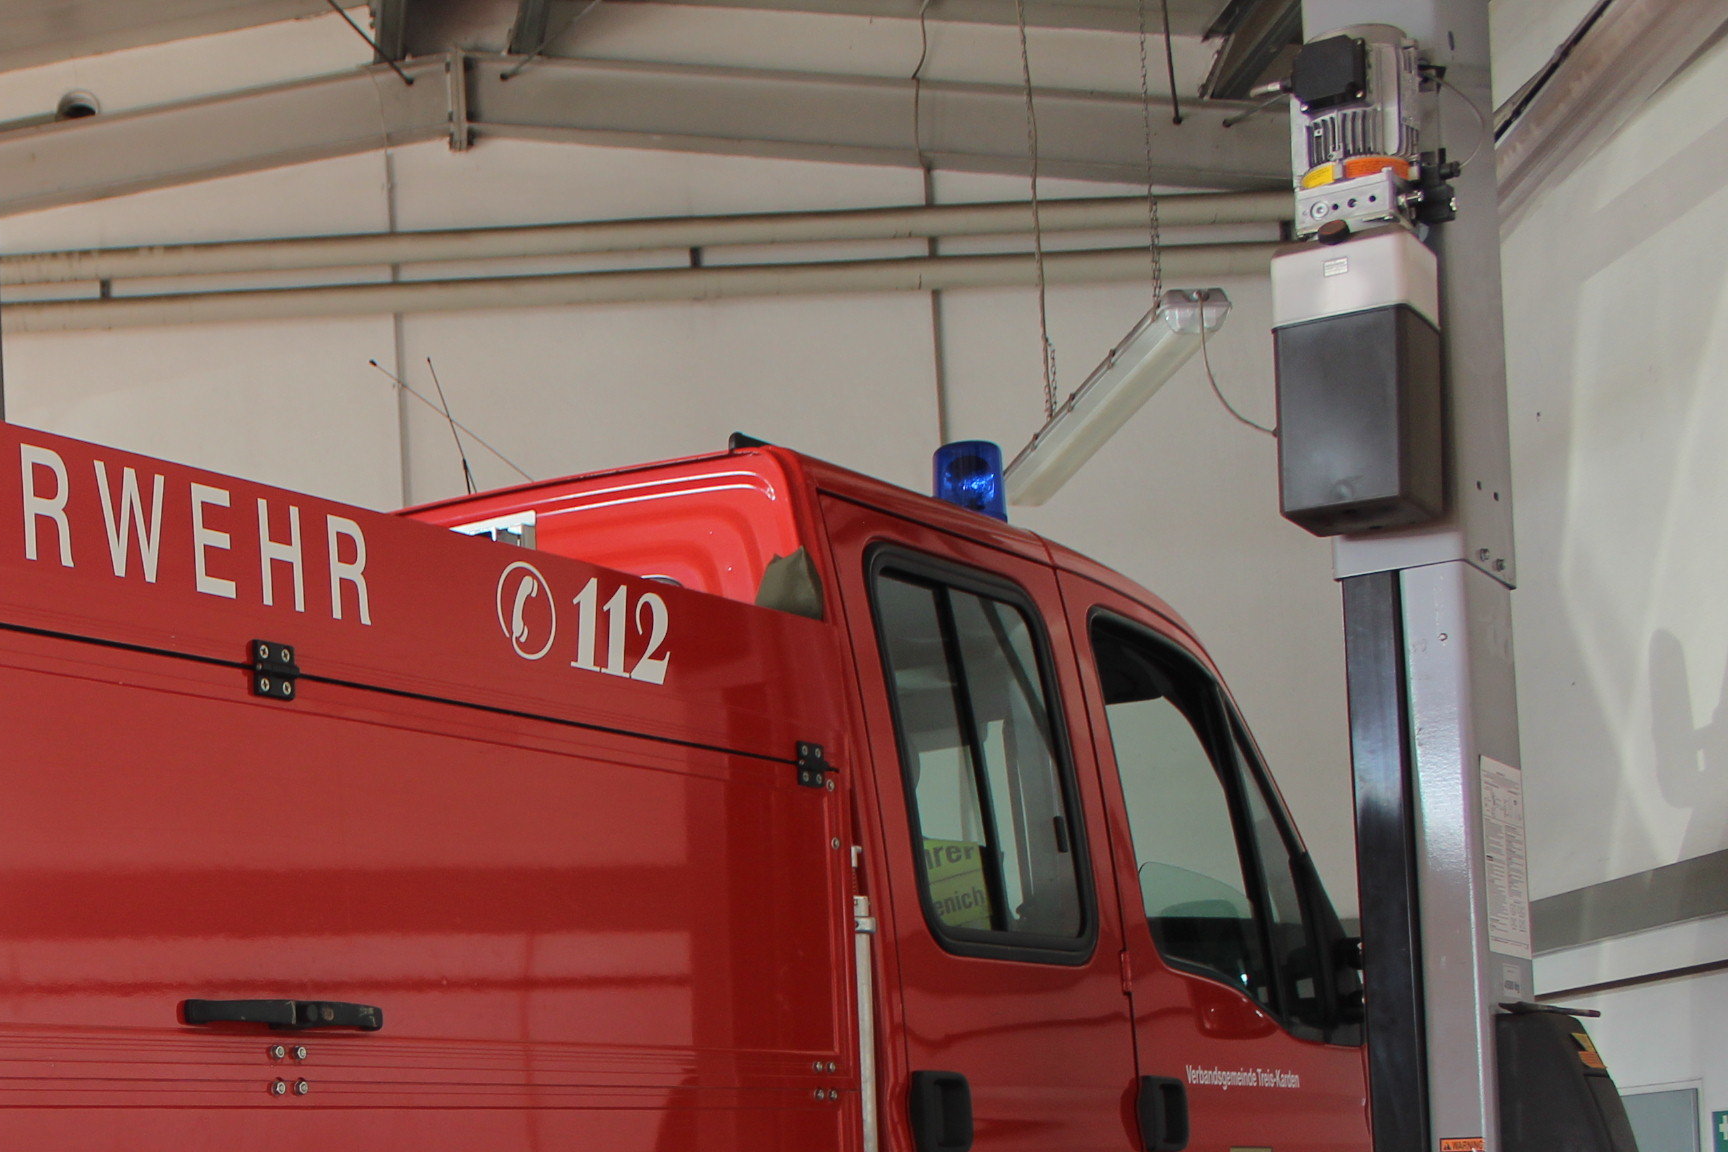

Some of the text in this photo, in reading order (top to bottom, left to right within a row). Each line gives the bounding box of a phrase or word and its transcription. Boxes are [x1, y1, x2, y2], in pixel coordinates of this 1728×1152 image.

[569, 576, 672, 686] 112
[1185, 1064, 1300, 1091] Verbandsgemeinde Treis-Karden
